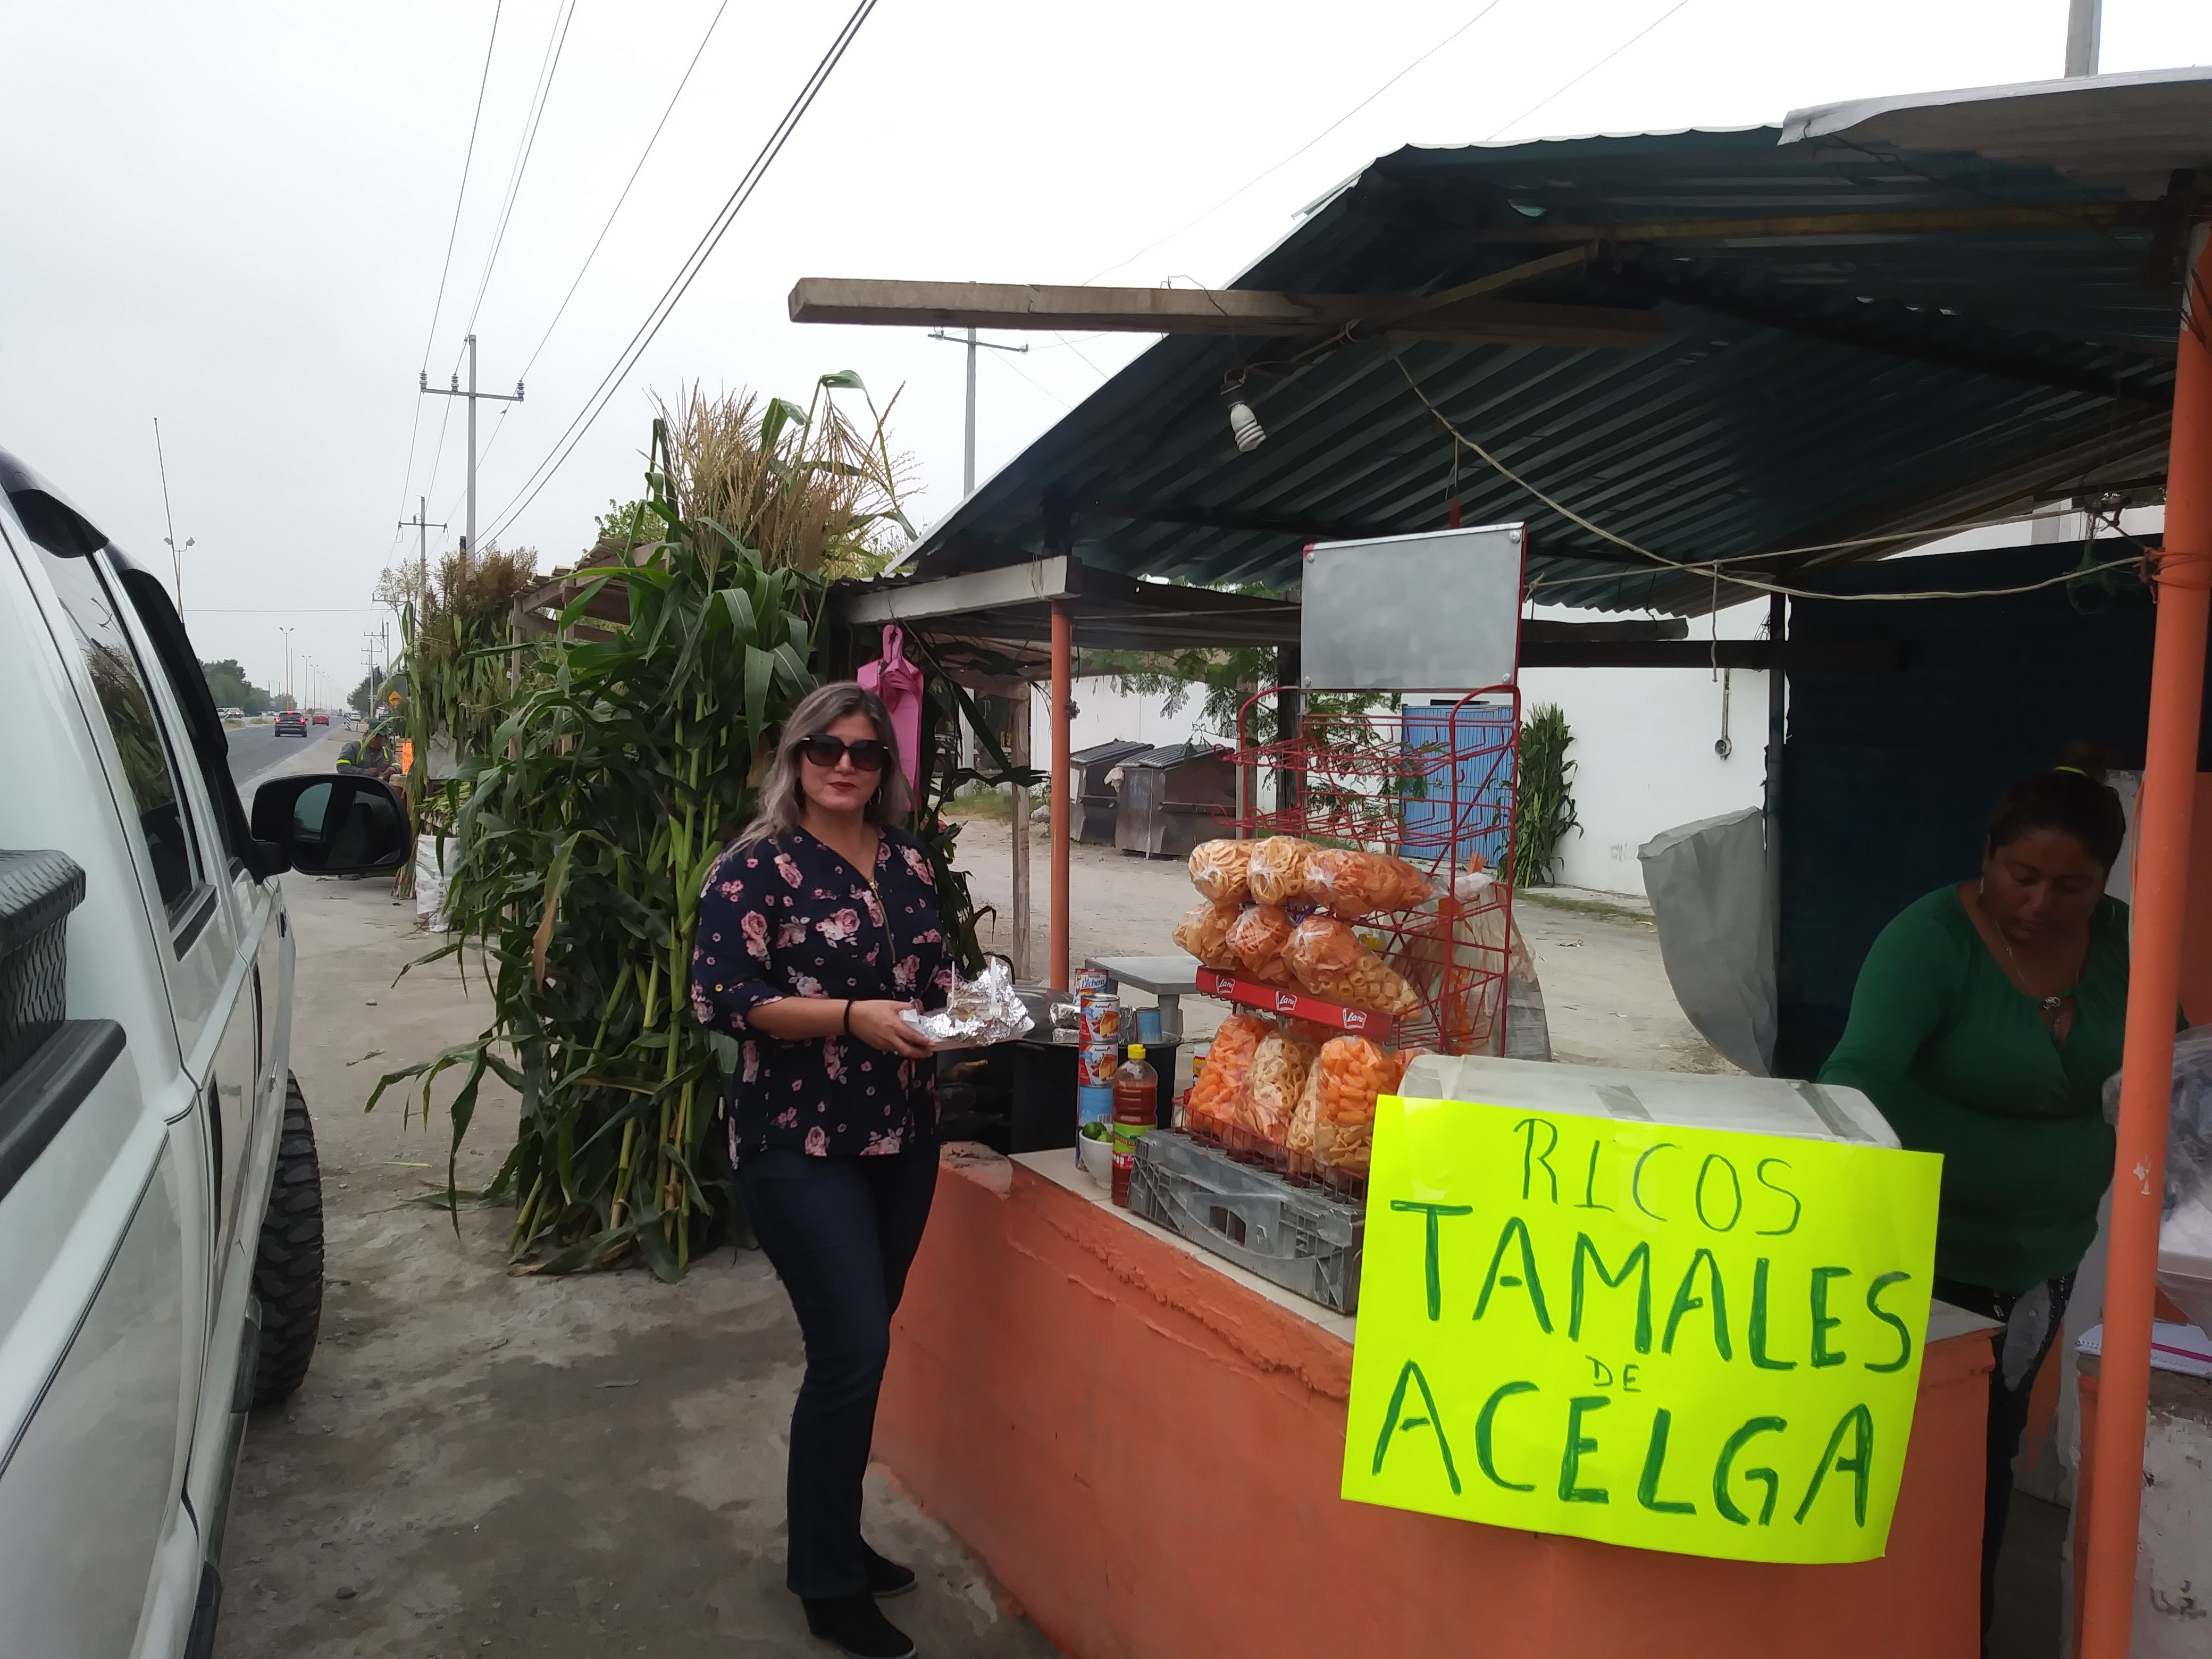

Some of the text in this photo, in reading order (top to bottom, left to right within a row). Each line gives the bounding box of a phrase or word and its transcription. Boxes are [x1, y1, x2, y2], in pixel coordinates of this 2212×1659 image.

[1082, 979, 1104, 988] Lechera
[1219, 978, 1233, 988] Lara
[1279, 994, 1295, 1005] Lara
[1346, 1011, 1364, 1023] Lara
[1513, 1118, 1802, 1235] RICOS
[1390, 1200, 1912, 1375] TAMALES
[1585, 1356, 1641, 1393] DE
[1371, 1359, 1874, 1528] ACELGA
